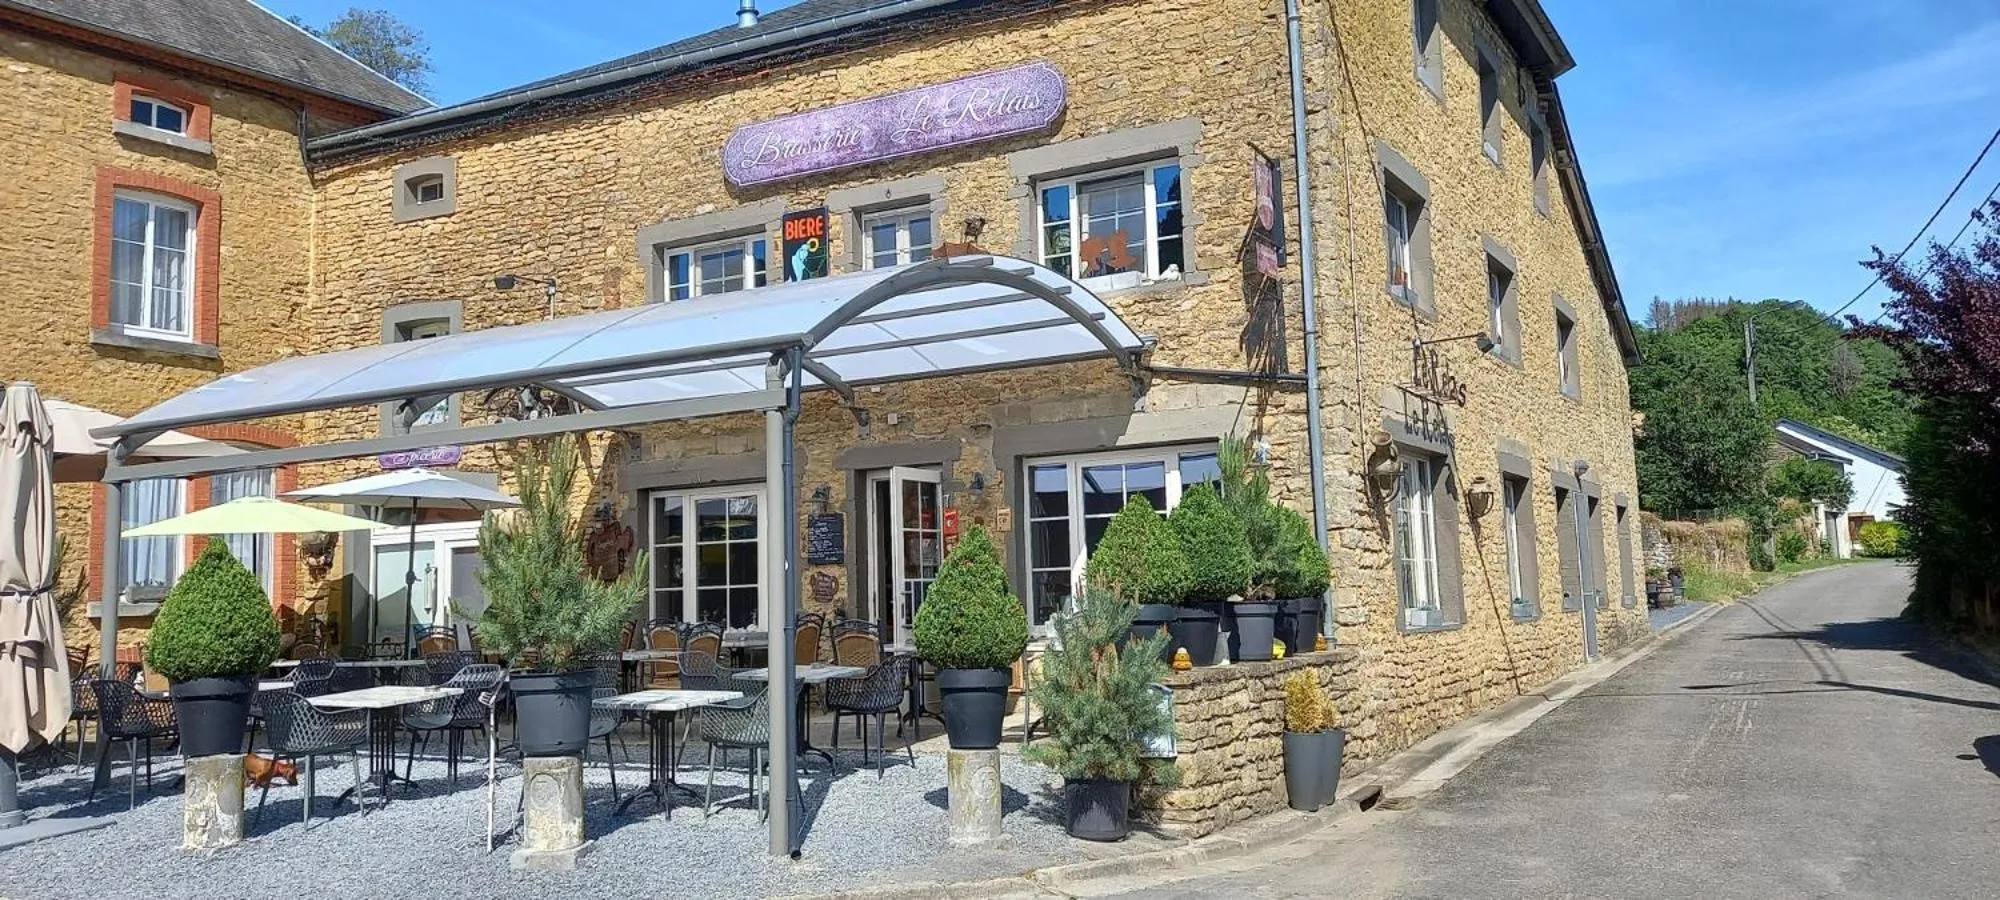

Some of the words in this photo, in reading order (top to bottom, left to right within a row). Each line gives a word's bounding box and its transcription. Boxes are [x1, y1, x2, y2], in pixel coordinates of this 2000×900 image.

[741, 128, 862, 169] Brasserie
[890, 95, 933, 143] Le
[942, 86, 1041, 128] Relais
[785, 215, 824, 240] BIERE
